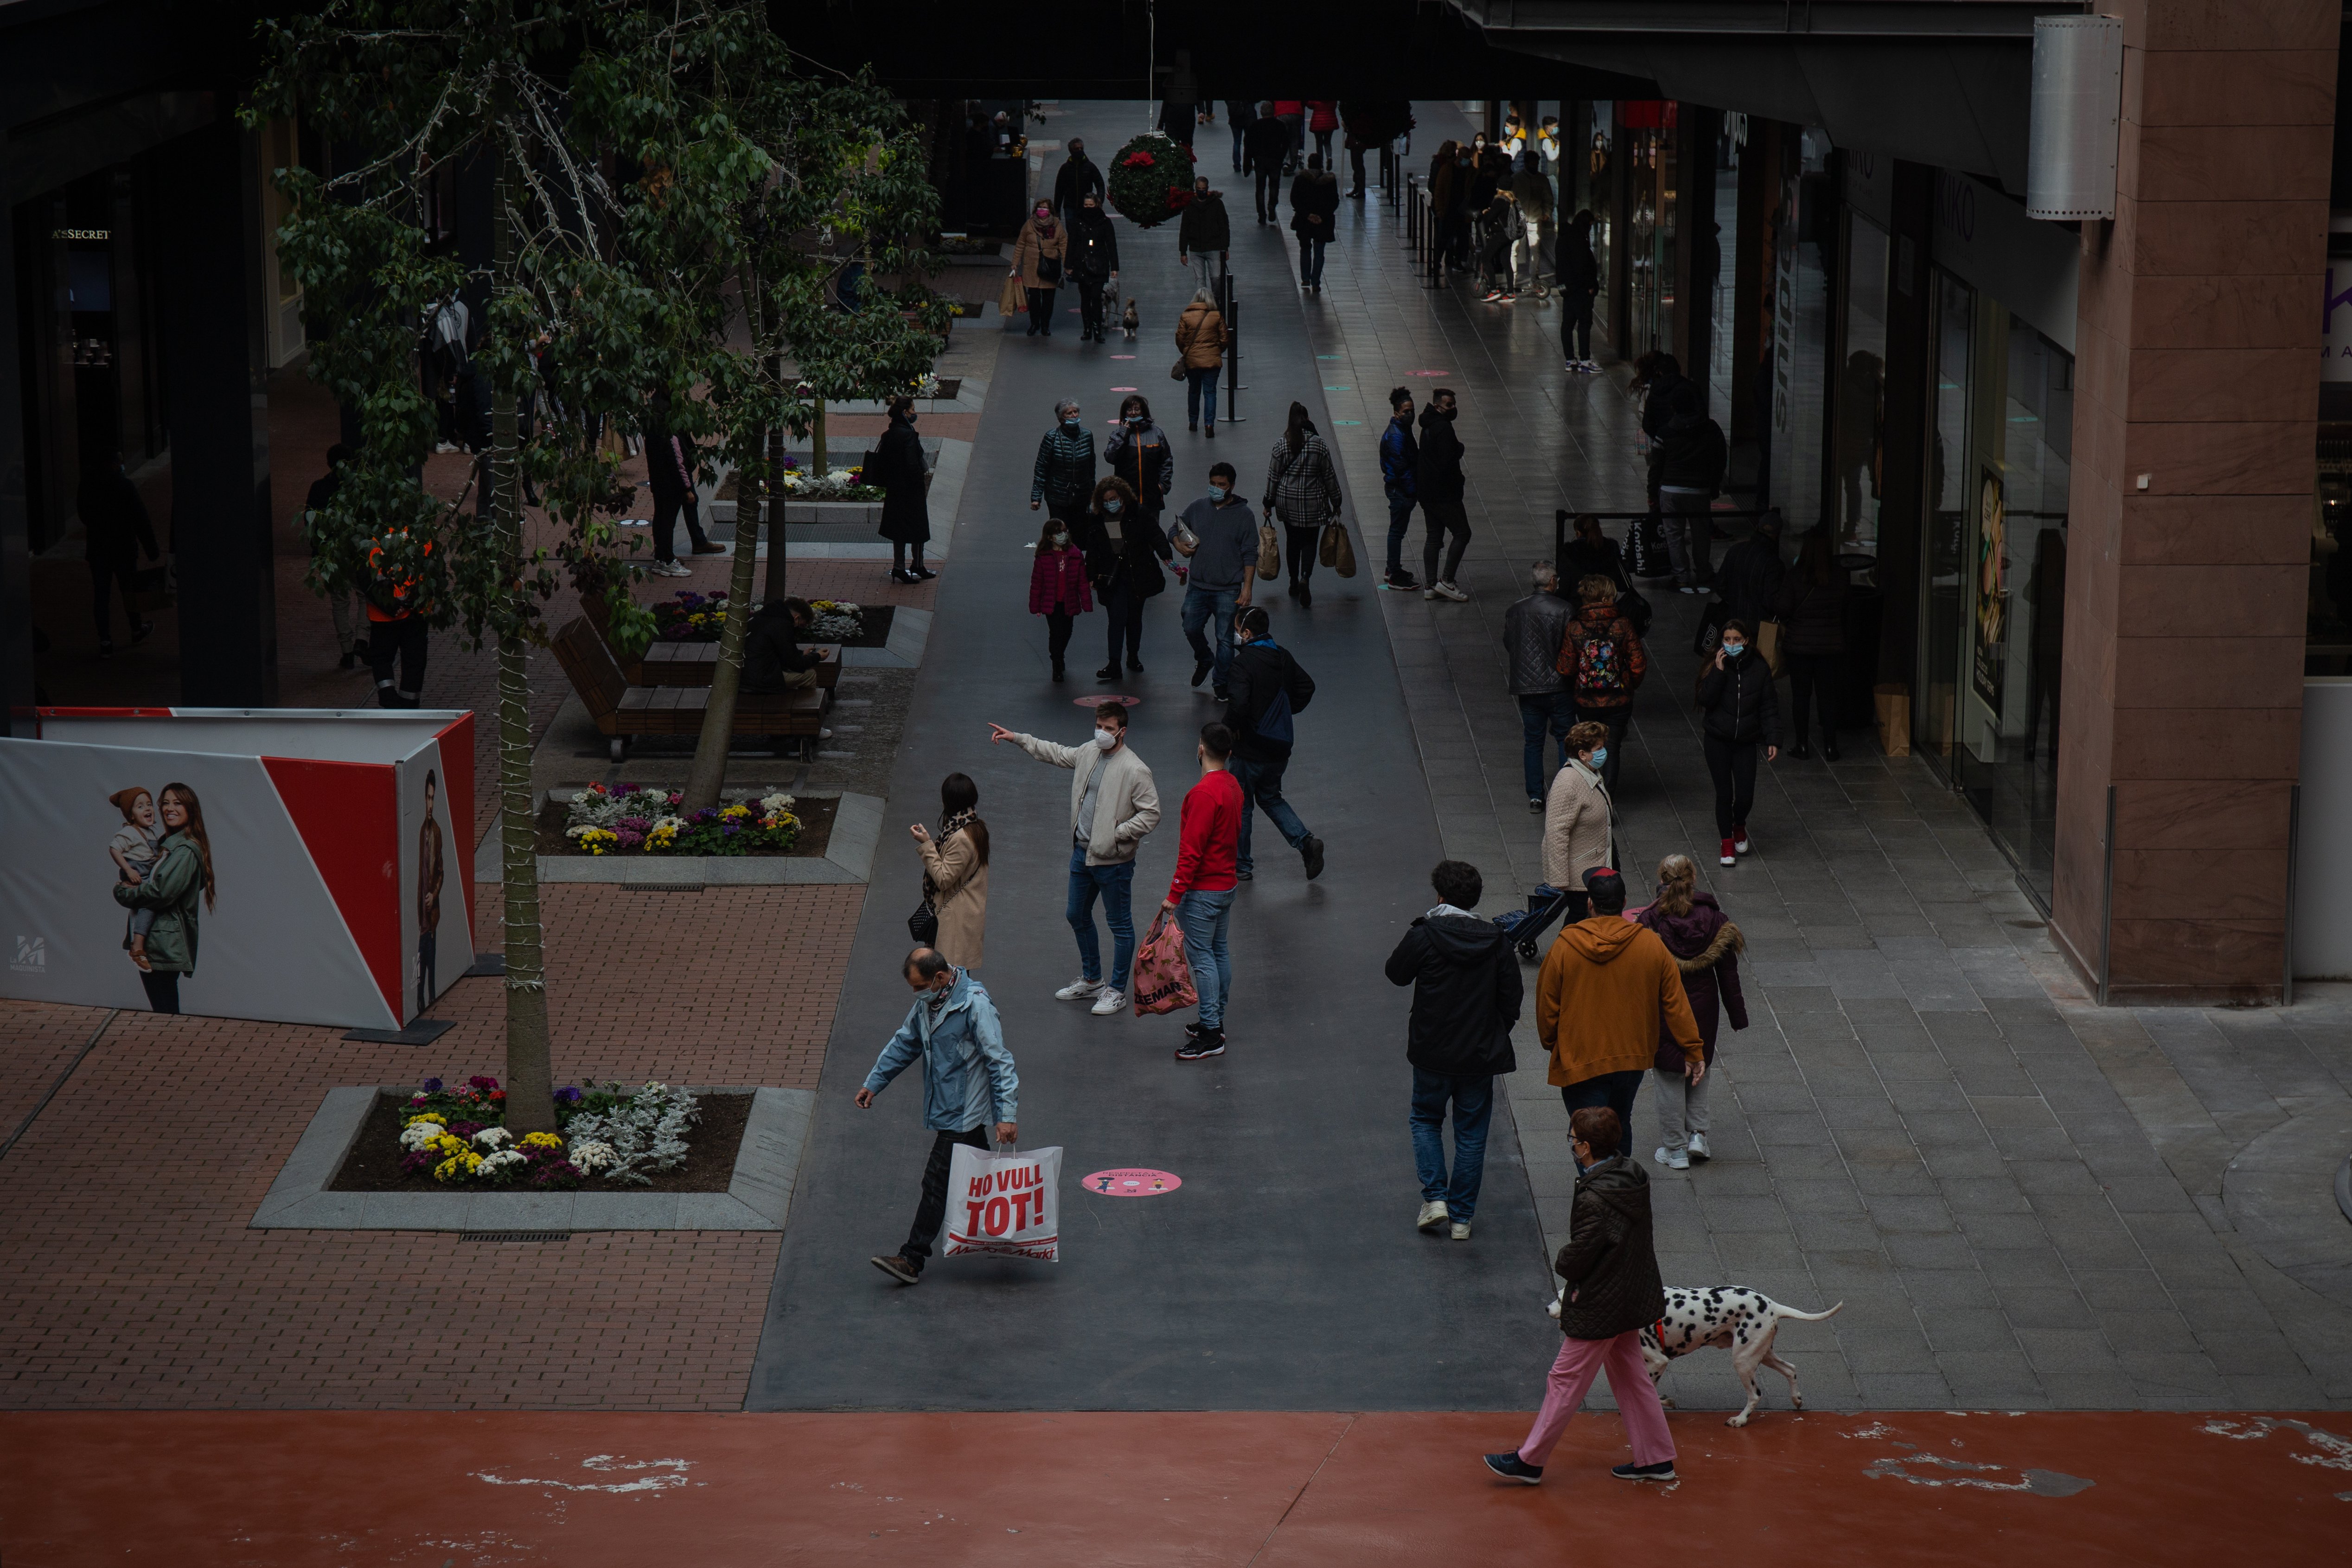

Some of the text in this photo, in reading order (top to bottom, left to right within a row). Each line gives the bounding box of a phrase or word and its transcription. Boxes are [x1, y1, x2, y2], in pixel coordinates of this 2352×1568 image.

[68, 229, 111, 239] SECRET
[10, 964, 45, 973] MAQUINISTA
[969, 1164, 1044, 1197] HO VULL
[966, 1186, 1044, 1236] TOT!
